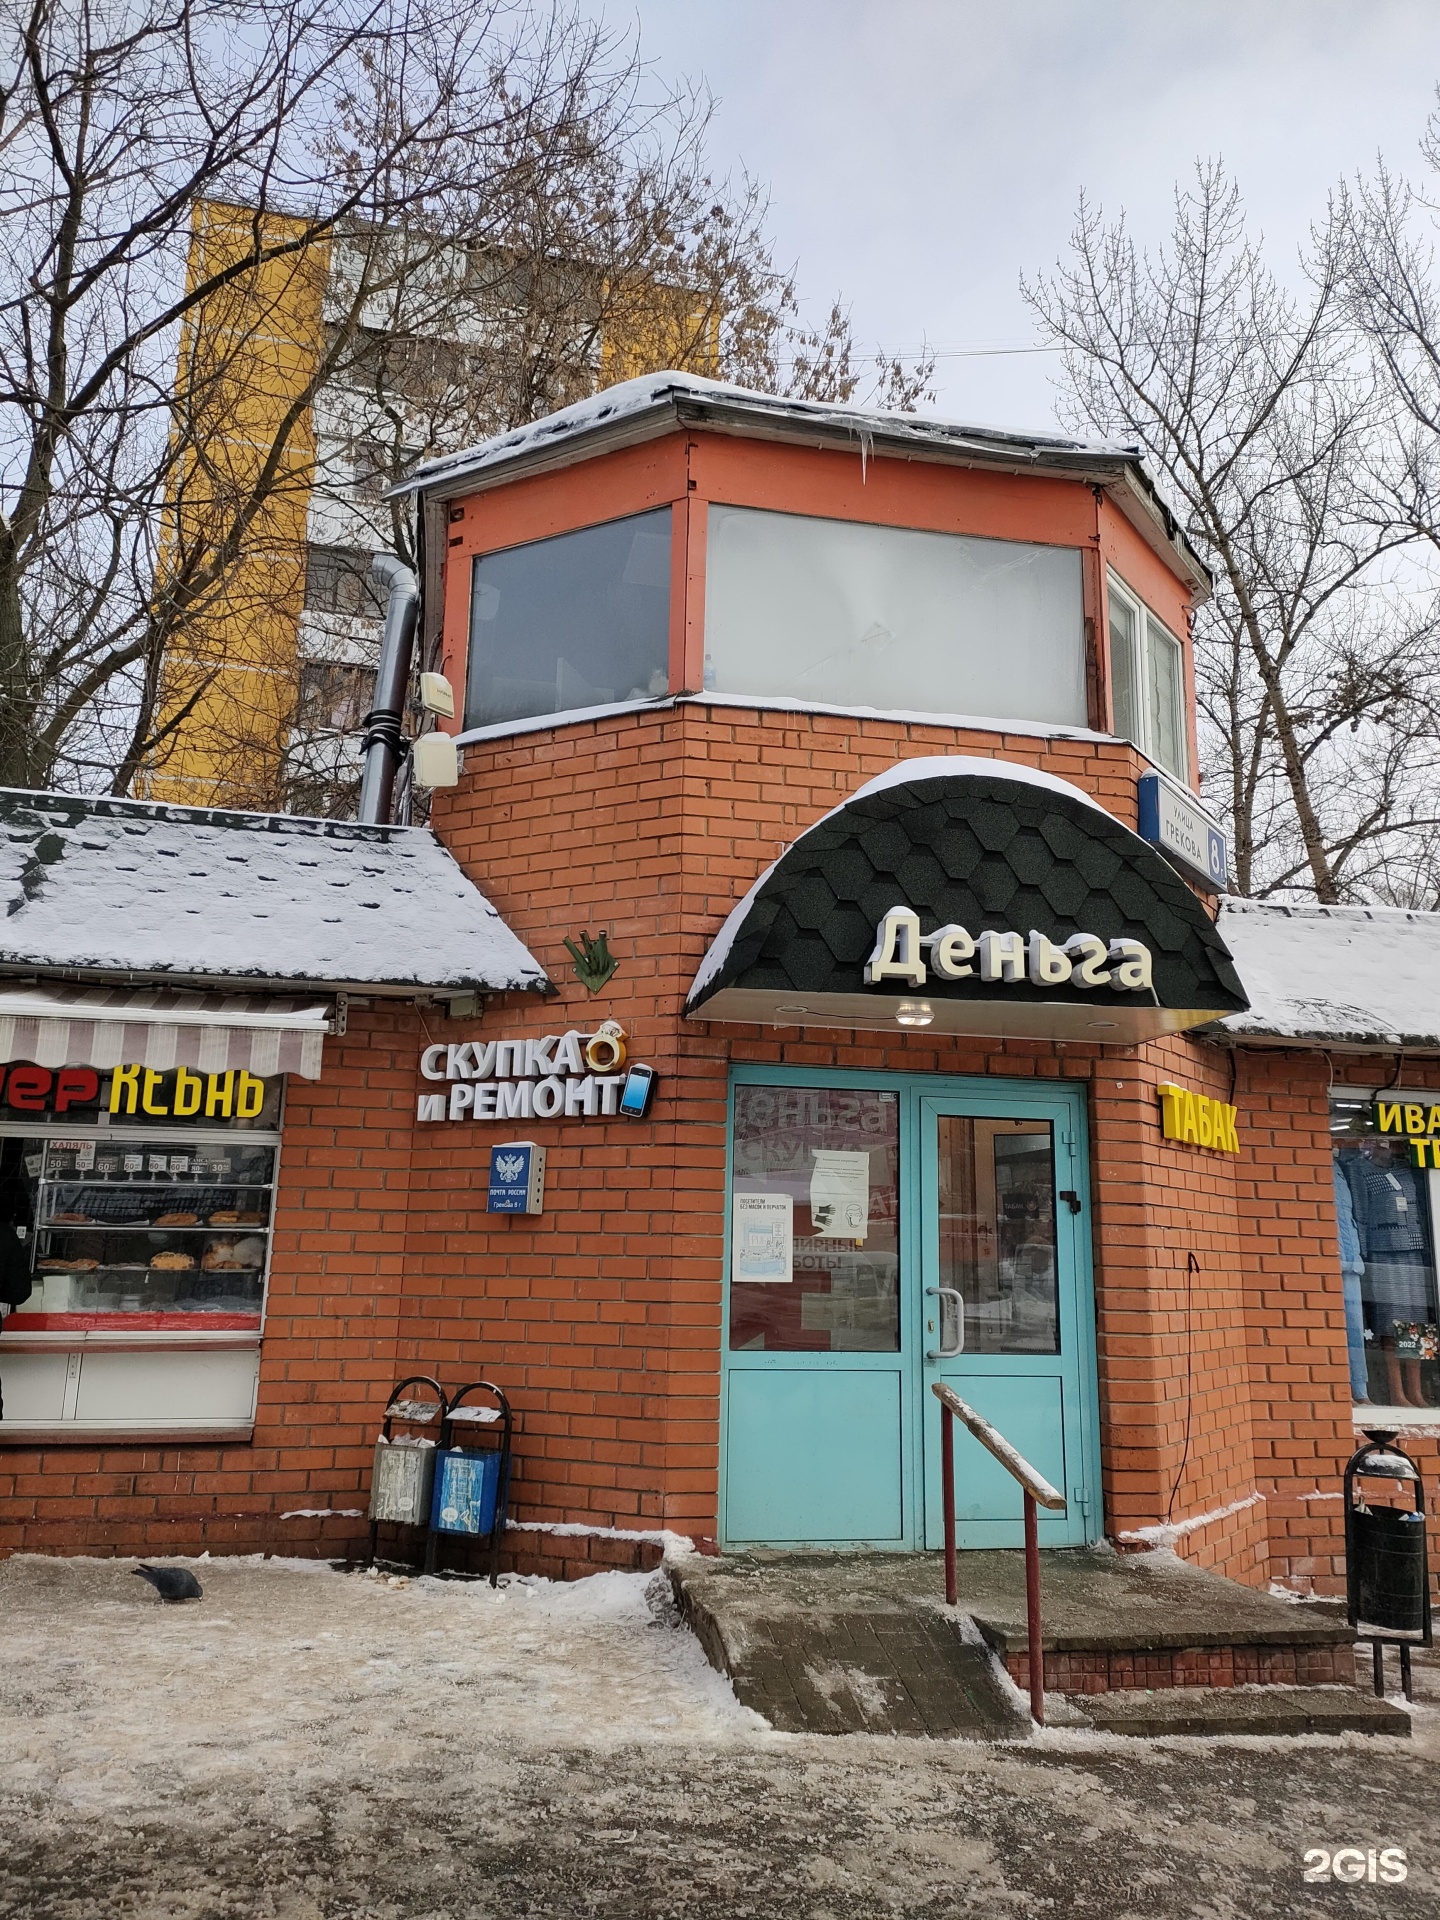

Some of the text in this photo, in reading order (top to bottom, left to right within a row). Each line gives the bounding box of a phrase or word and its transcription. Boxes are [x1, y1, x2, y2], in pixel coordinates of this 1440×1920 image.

[1173, 805, 1194, 833] УЛИЦА
[1165, 819, 1202, 862] ГРЕКОВА
[864, 914, 1152, 991] Деньга
[420, 1034, 585, 1081] СКУПКА
[0, 1066, 98, 1112] ер
[449, 1075, 627, 1121] РЕМОНТ
[738, 1091, 888, 1134] еньга
[1158, 1084, 1240, 1154] ТАБАК
[51, 1141, 93, 1150] ХАЛЯЛЬ
[50, 1160, 61, 1168] 50
[75, 1161, 86, 1169] 50
[97, 1163, 109, 1171] 60
[123, 1162, 134, 1170] 60
[149, 1162, 159, 1170] 60
[170, 1163, 180, 1171] 60
[212, 1164, 223, 1172] 30
